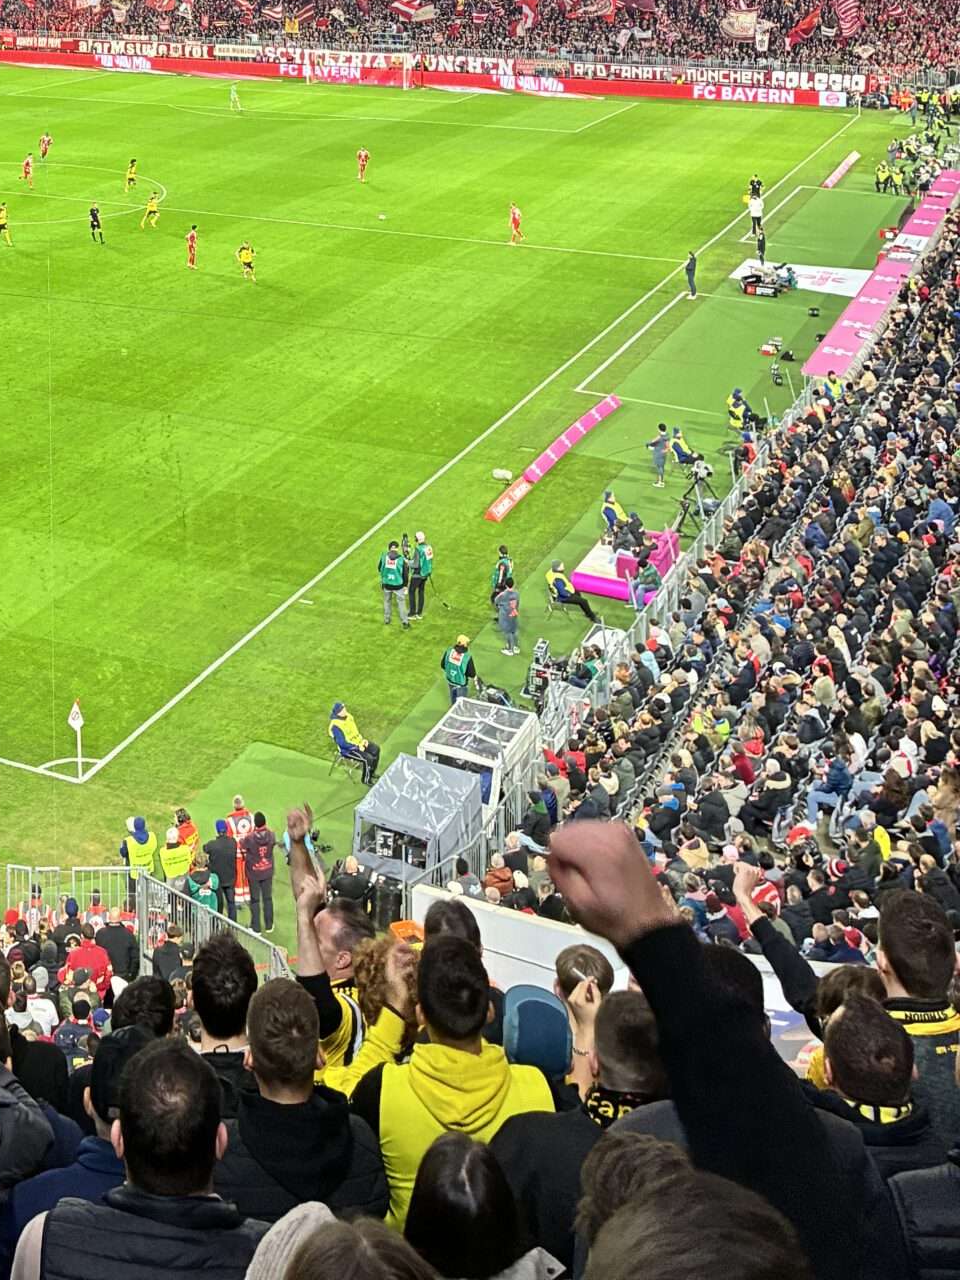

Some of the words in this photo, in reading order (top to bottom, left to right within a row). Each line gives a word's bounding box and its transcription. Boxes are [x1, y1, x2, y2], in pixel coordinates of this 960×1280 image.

[302, 65, 361, 79] BAYERN
[693, 86, 717, 99] FC
[721, 87, 794, 104] BAYERN
